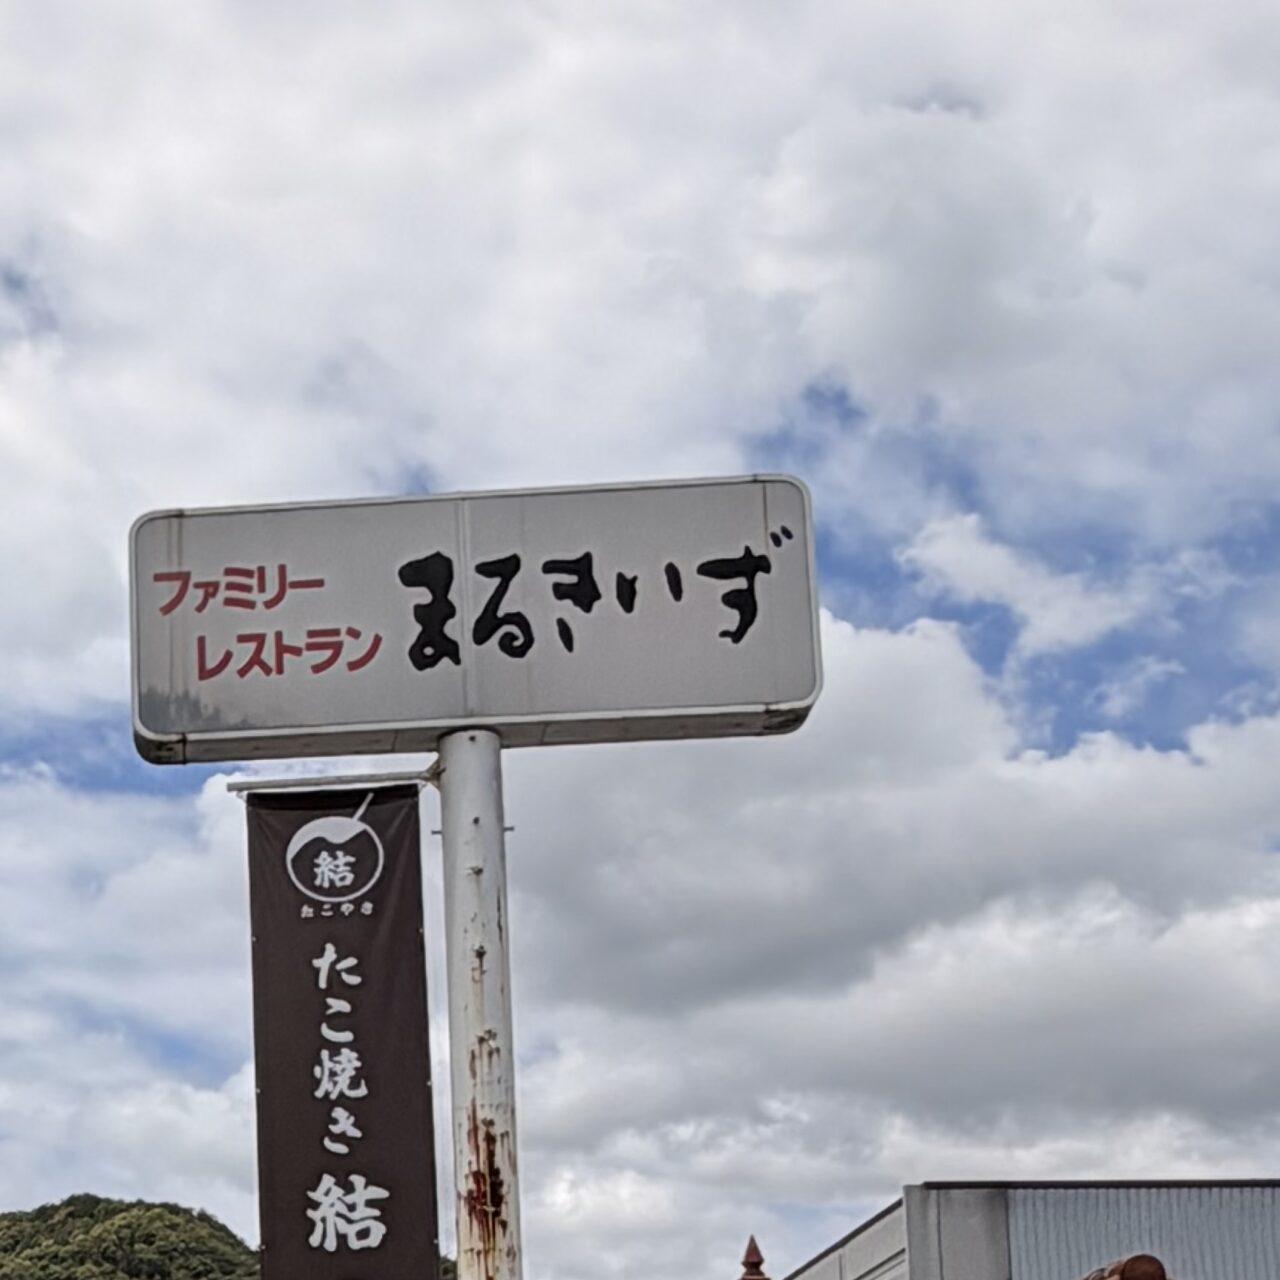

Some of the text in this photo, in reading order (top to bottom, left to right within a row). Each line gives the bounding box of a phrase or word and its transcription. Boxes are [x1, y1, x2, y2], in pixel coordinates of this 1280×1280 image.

[152, 563, 325, 616] ファミリー
[196, 626, 383, 682] レストラン
[313, 850, 357, 889] 結
[305, 1173, 391, 1252] 結
